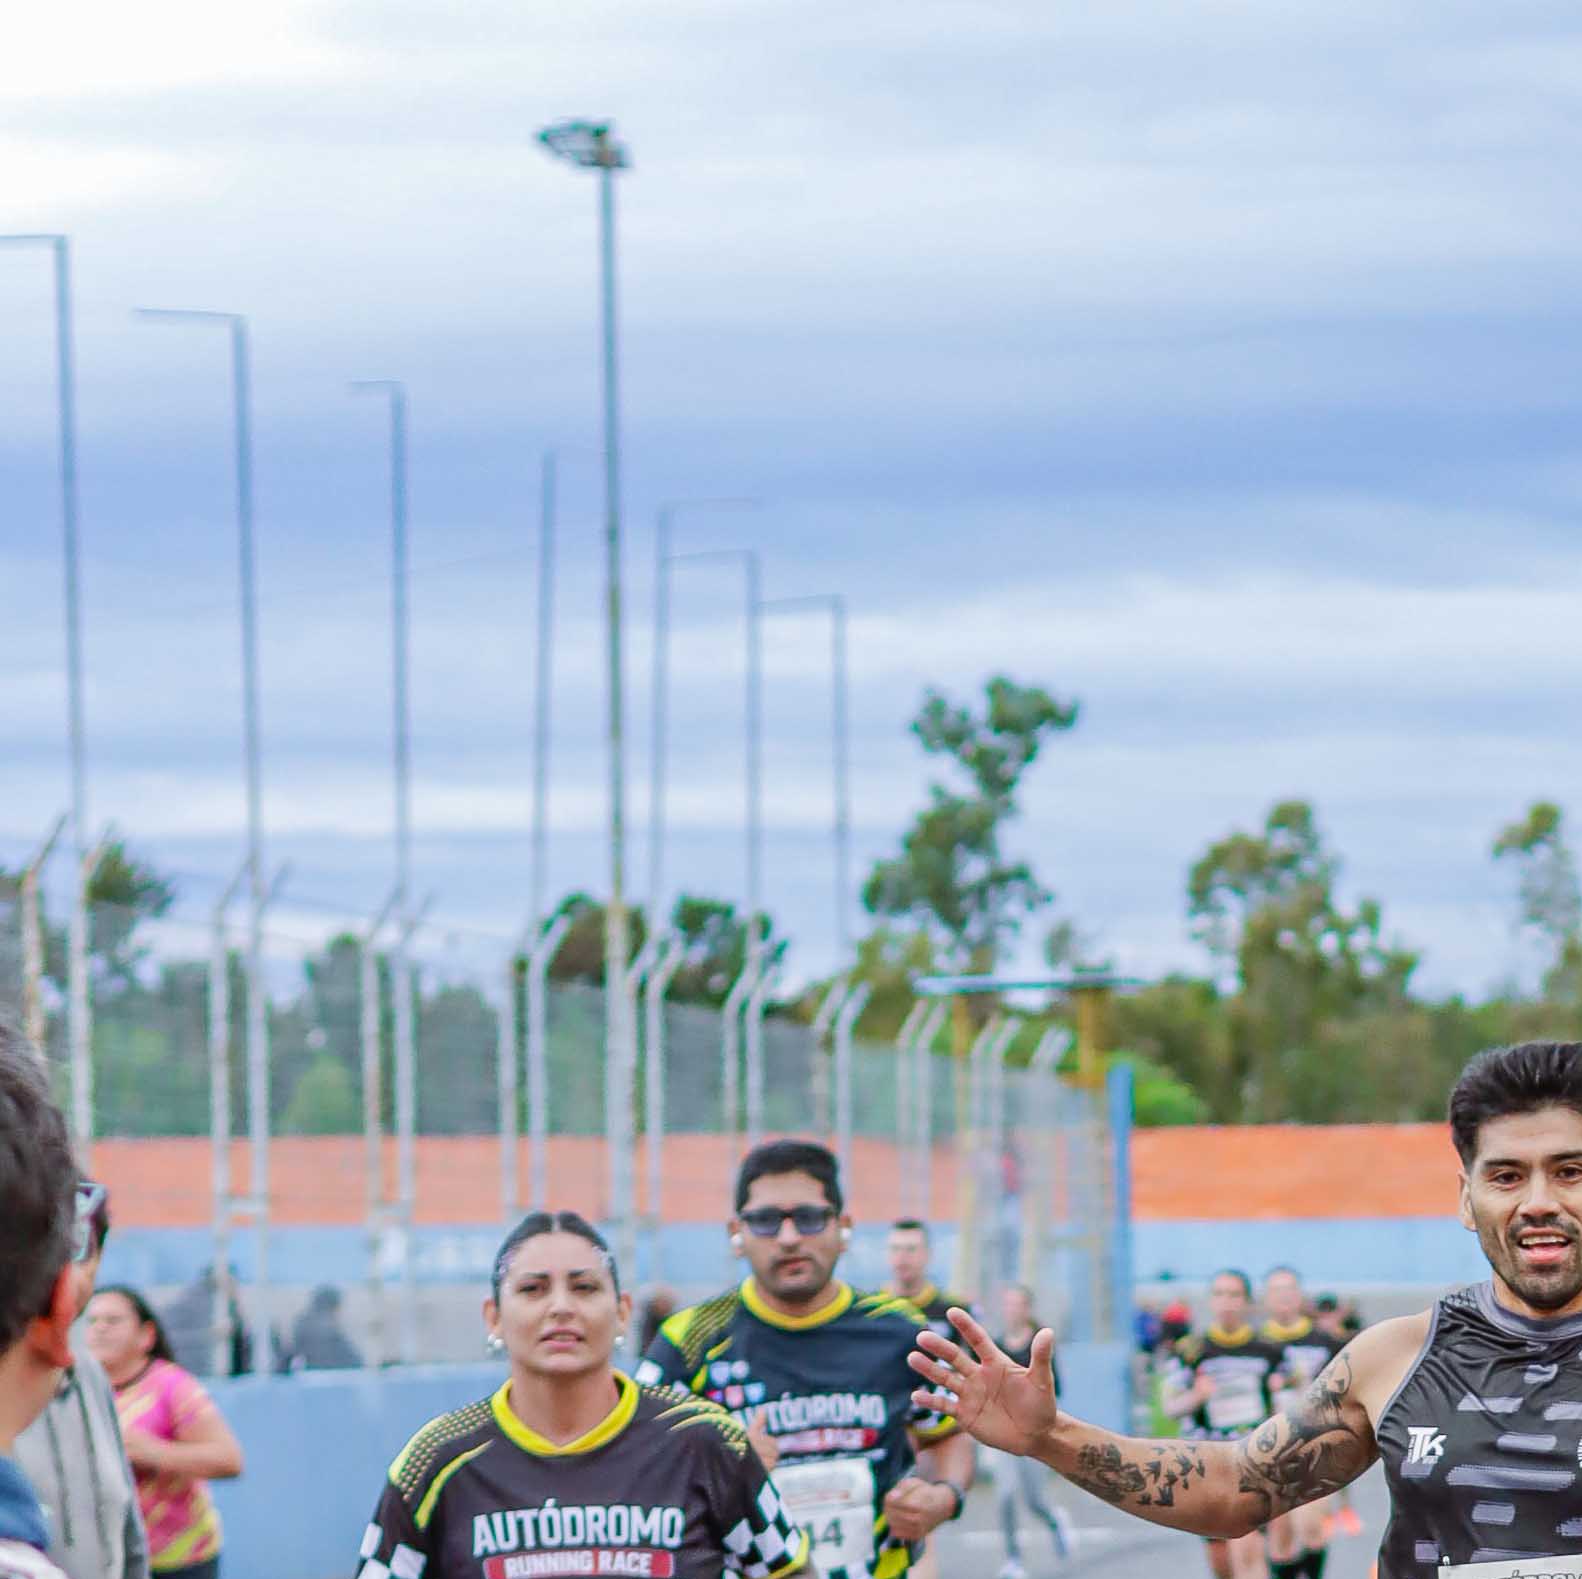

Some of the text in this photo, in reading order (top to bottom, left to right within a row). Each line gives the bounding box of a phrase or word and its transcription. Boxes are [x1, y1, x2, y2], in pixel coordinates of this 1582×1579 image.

[473, 1497, 686, 1557] AUTÓDROMO
[504, 1551, 652, 1579] RUNNING RACE
